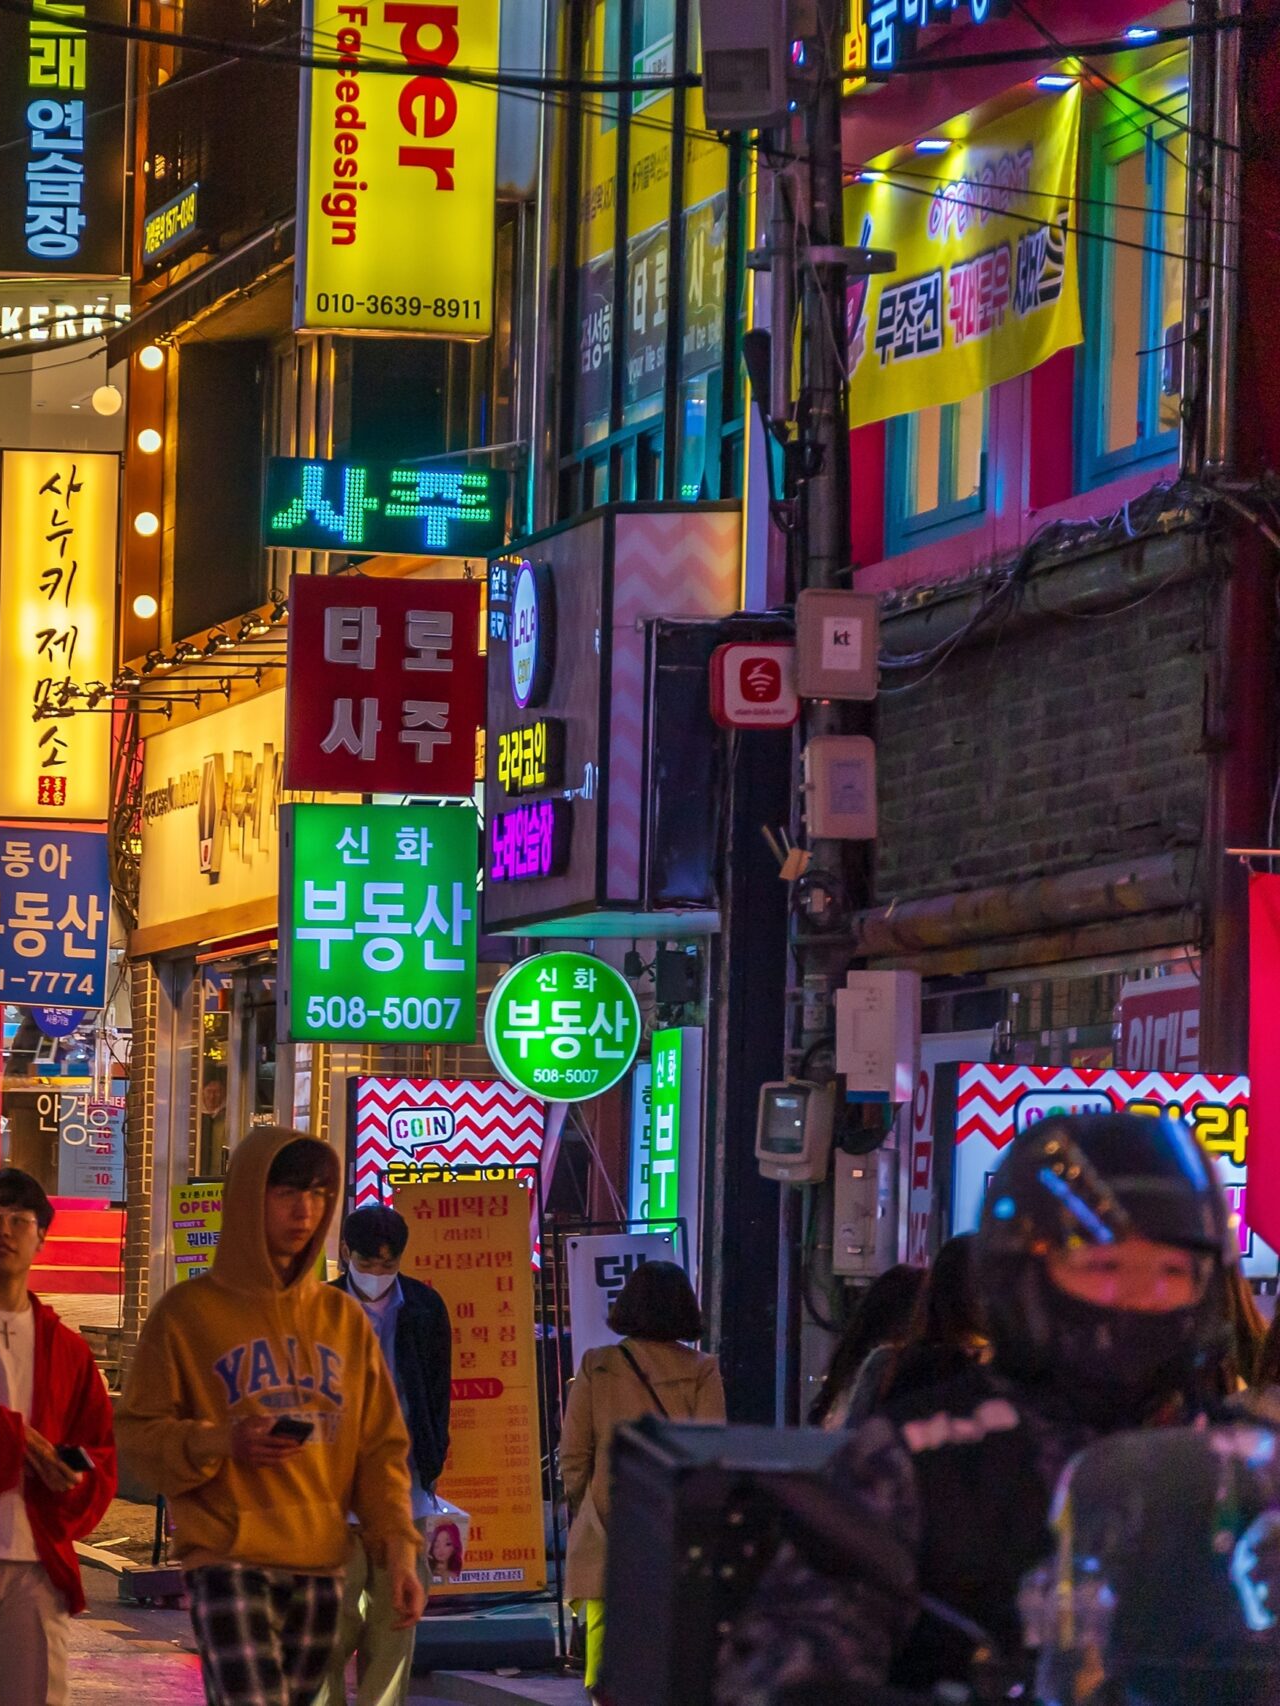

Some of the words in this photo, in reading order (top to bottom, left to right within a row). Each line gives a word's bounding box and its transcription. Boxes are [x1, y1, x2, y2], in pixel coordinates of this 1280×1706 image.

[322, 5, 367, 246] Facedesign
[25, 100, 86, 259] 연습장
[316, 292, 481, 321] 010-3639-8911
[875, 267, 943, 371] 무조건
[272, 465, 491, 546] 사주
[39, 464, 83, 608] 사누키
[323, 606, 455, 672] 타로
[514, 606, 536, 648] LALA
[834, 631, 851, 646] kt
[320, 697, 452, 763] 사주
[498, 722, 546, 792] 라라코인
[0, 841, 72, 879] 동아
[336, 826, 433, 866] 신화
[492, 802, 553, 881] 노래연습장
[296, 882, 471, 972] 부동산
[536, 968, 597, 993] 신화
[306, 996, 461, 1030] 508-5007
[503, 1000, 629, 1060] 부동산
[533, 1067, 599, 1083] 508-5007
[36, 1093, 112, 1148] 안경은
[395, 1115, 449, 1139] COIN
[179, 1200, 222, 1214] OPEN
[412, 1195, 509, 1219] 슈퍼왁싱
[414, 1251, 513, 1270] 브라질리언
[213, 1335, 344, 1410] YALE
